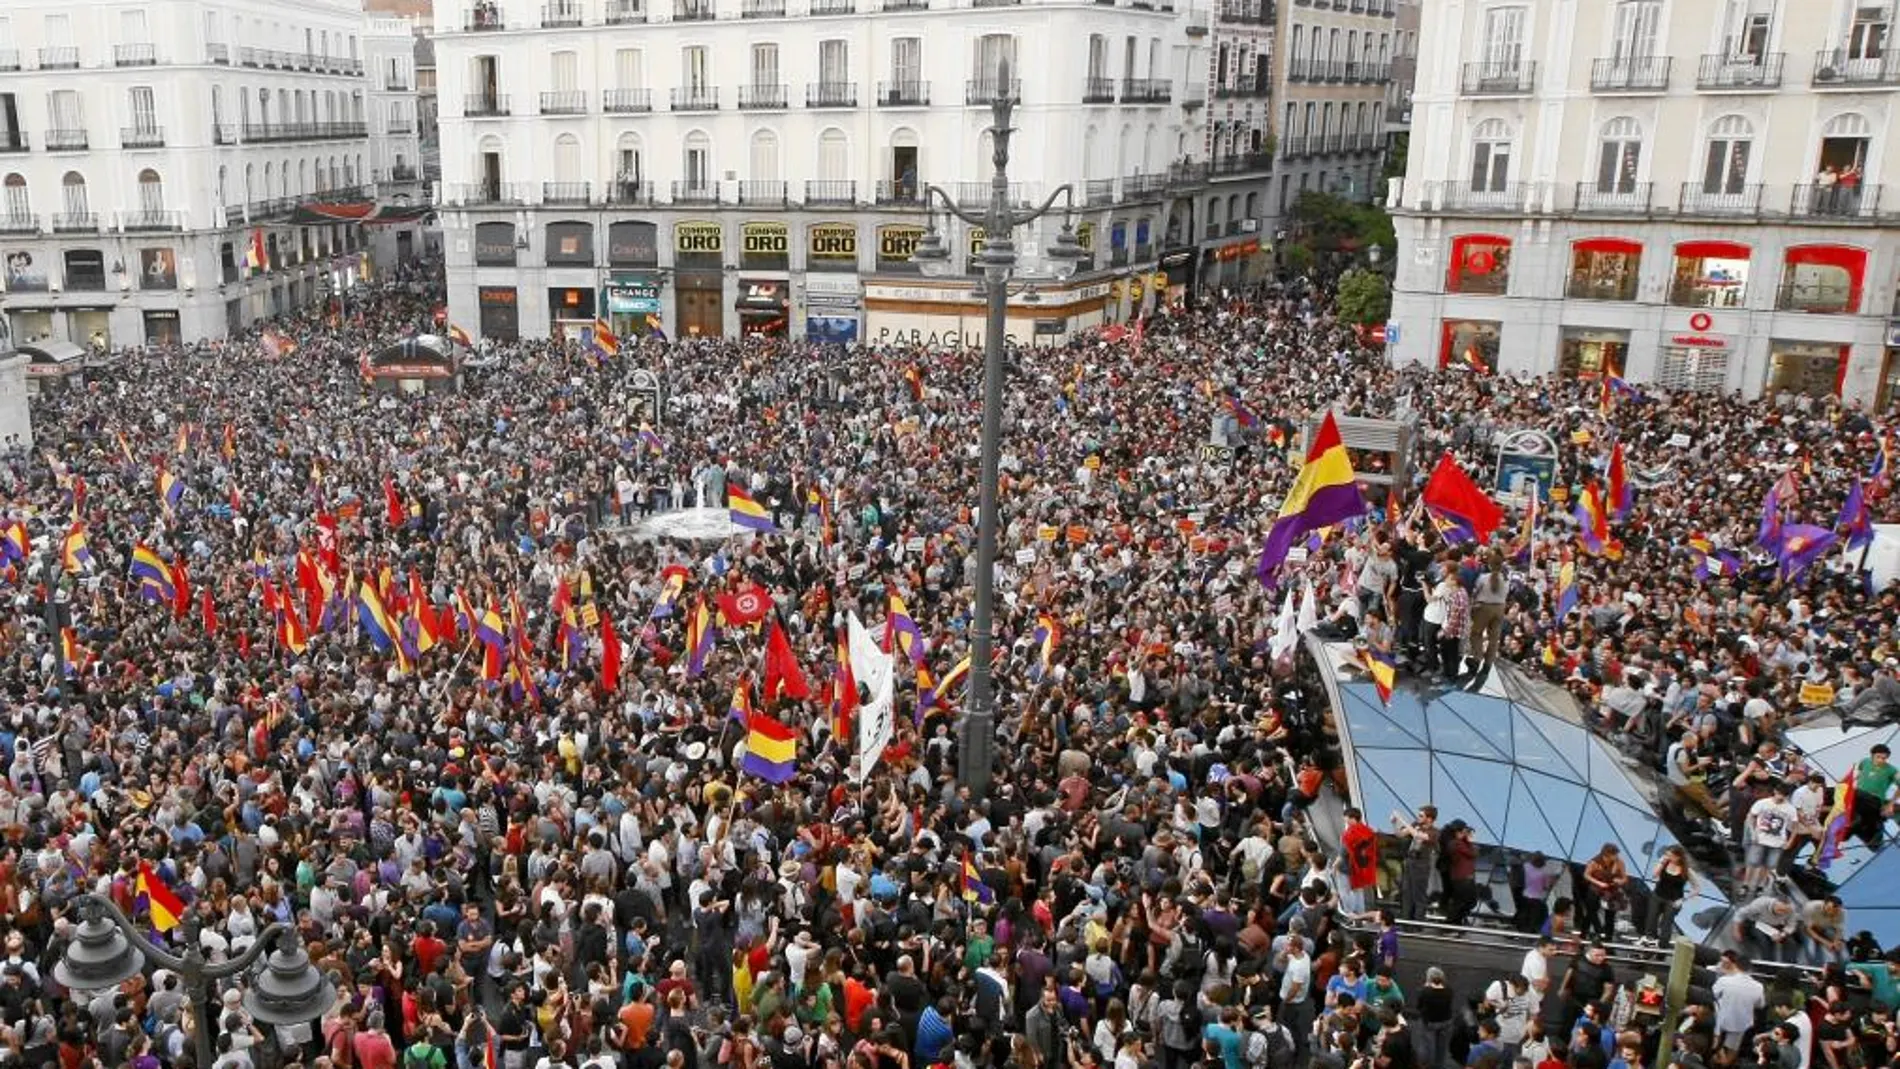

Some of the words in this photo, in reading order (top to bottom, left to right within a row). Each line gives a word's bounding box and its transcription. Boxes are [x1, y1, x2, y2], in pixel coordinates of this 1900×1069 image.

[678, 226, 720, 236] COMPRO
[744, 227, 787, 236] COMPRO
[812, 228, 856, 238] COMPRO
[882, 229, 925, 239] COMPR
[679, 235, 721, 250] ORO
[744, 236, 787, 251] ORO
[812, 237, 856, 253] ORO
[612, 288, 656, 298] CHANGE
[879, 326, 1019, 350] PARAGUS
